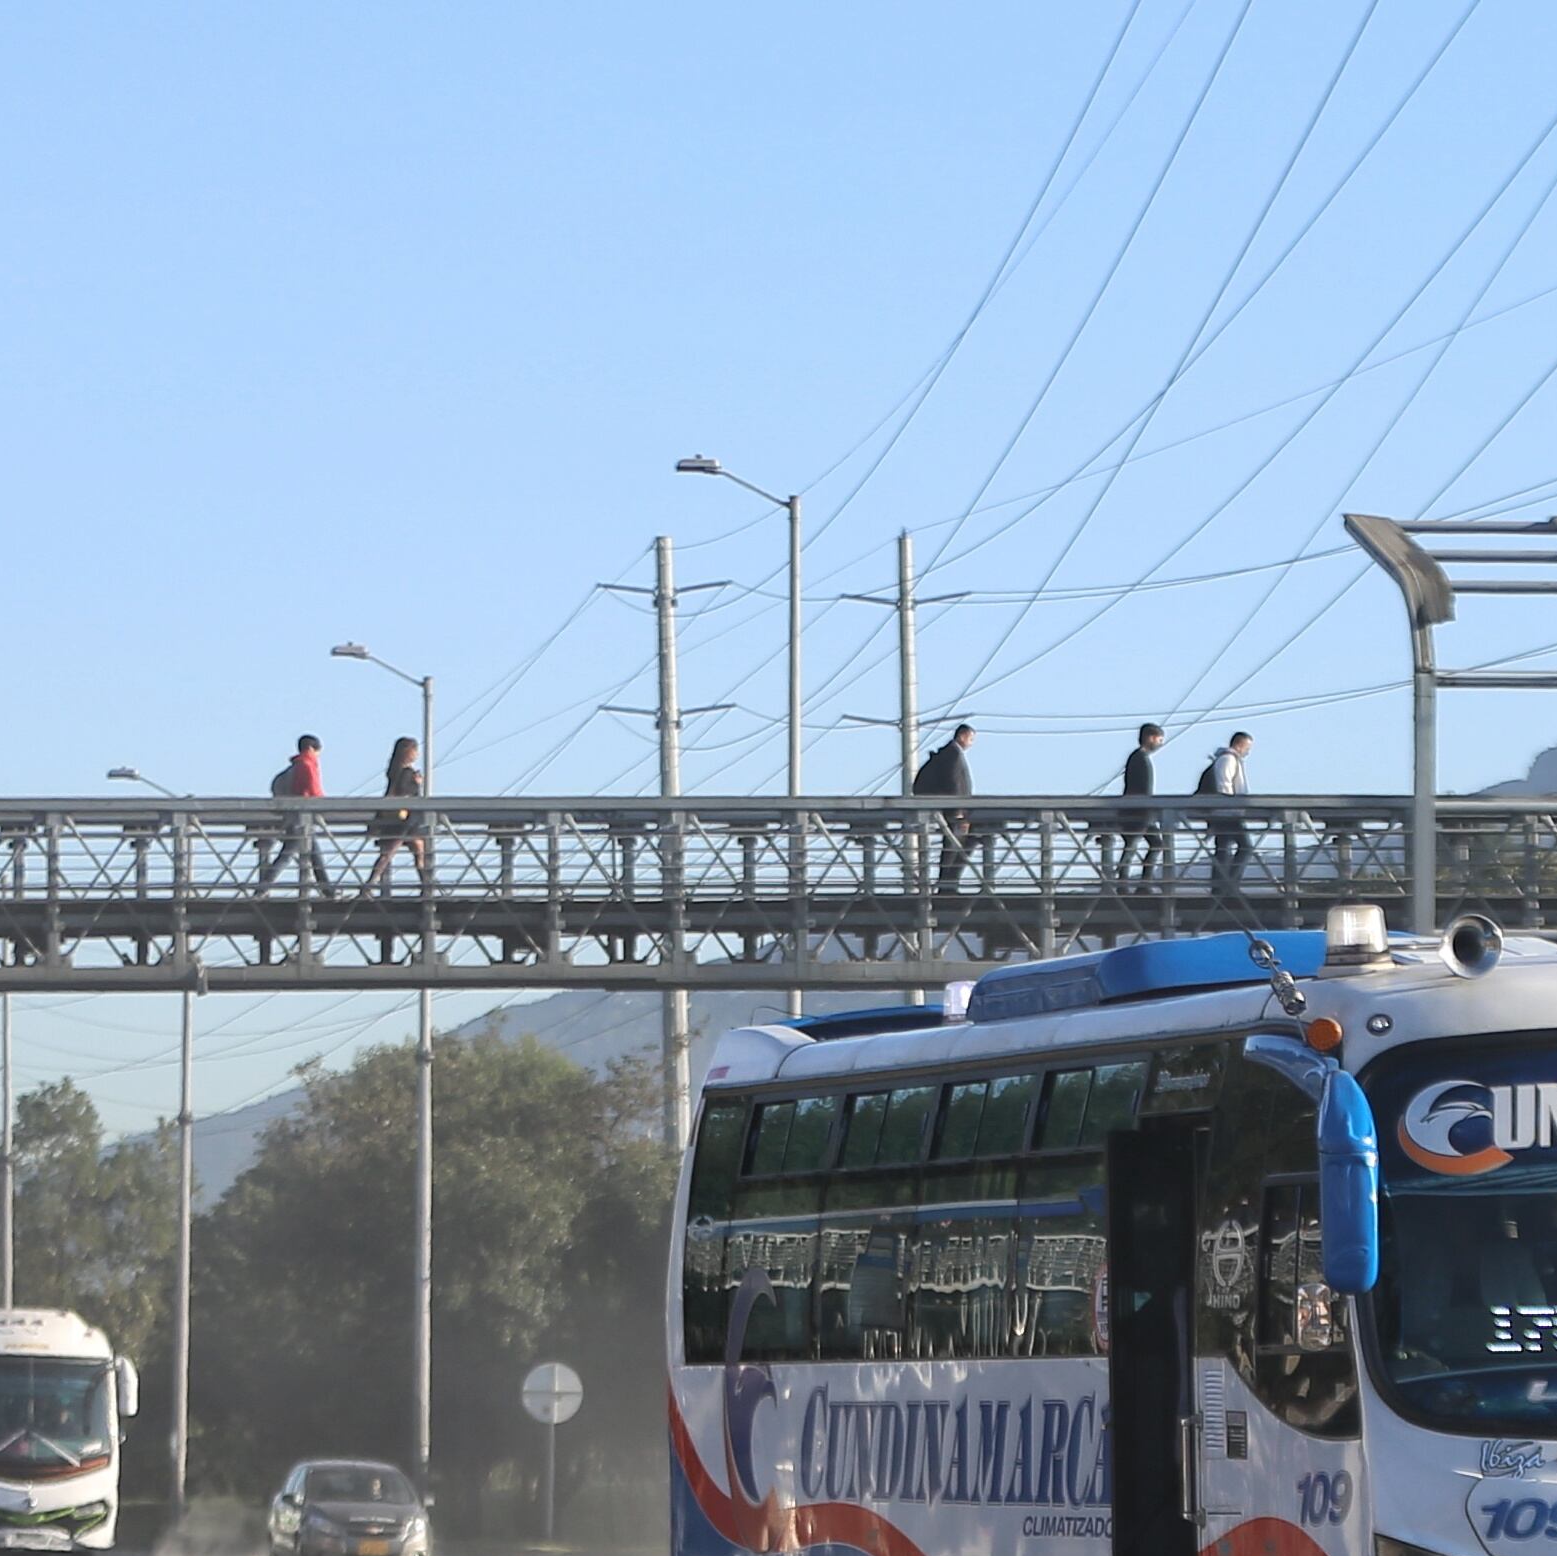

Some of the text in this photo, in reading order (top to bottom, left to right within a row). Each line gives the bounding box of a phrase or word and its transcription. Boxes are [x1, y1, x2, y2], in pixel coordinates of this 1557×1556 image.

[800, 1381, 1112, 1509] CUNDINAMARCA
[1481, 1440, 1546, 1479] Ibiza
[1298, 1471, 1353, 1527] 109
[1023, 1516, 1113, 1538] CLIMATIZADO
